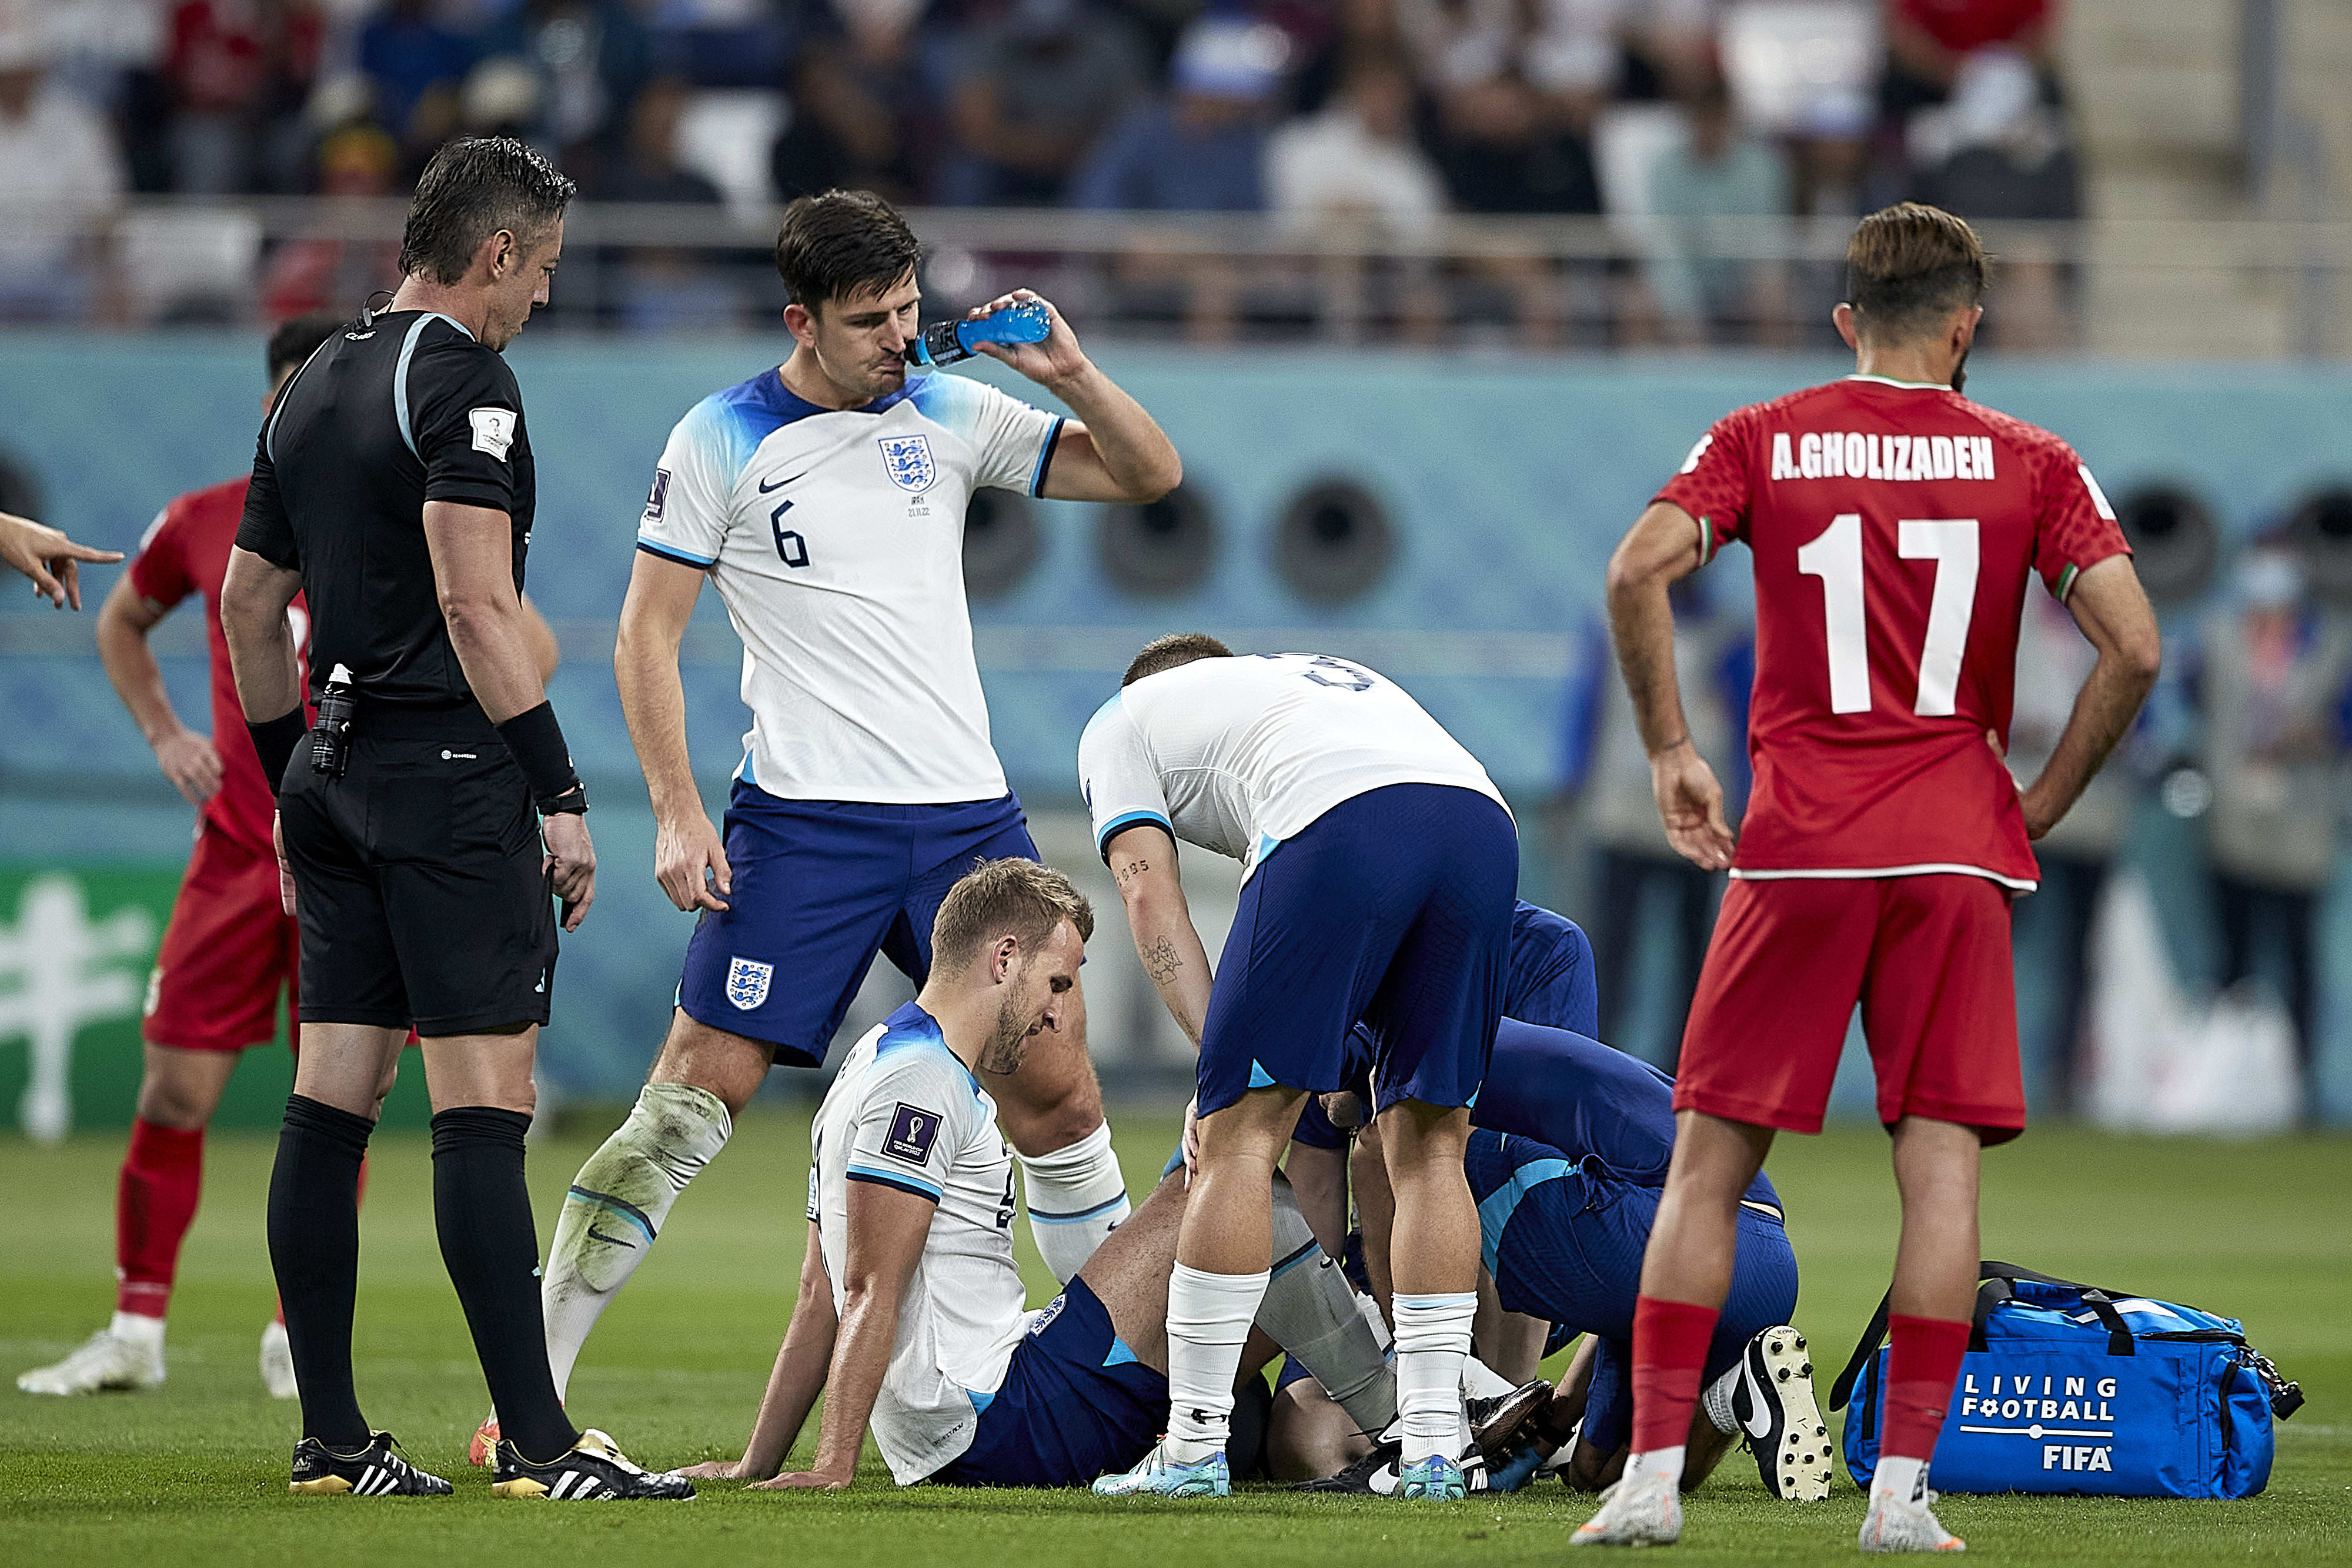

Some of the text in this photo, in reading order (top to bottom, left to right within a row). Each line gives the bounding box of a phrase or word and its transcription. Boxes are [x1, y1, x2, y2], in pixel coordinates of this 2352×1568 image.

[1771, 432, 1996, 482] A.GHOLIZADEH
[770, 499, 810, 569] 6
[1798, 513, 1980, 717] 17
[1965, 1374, 2116, 1398] LIVING
[1962, 1397, 2114, 1421] FOOTBALL
[2043, 1445, 2112, 1472] FIFA
